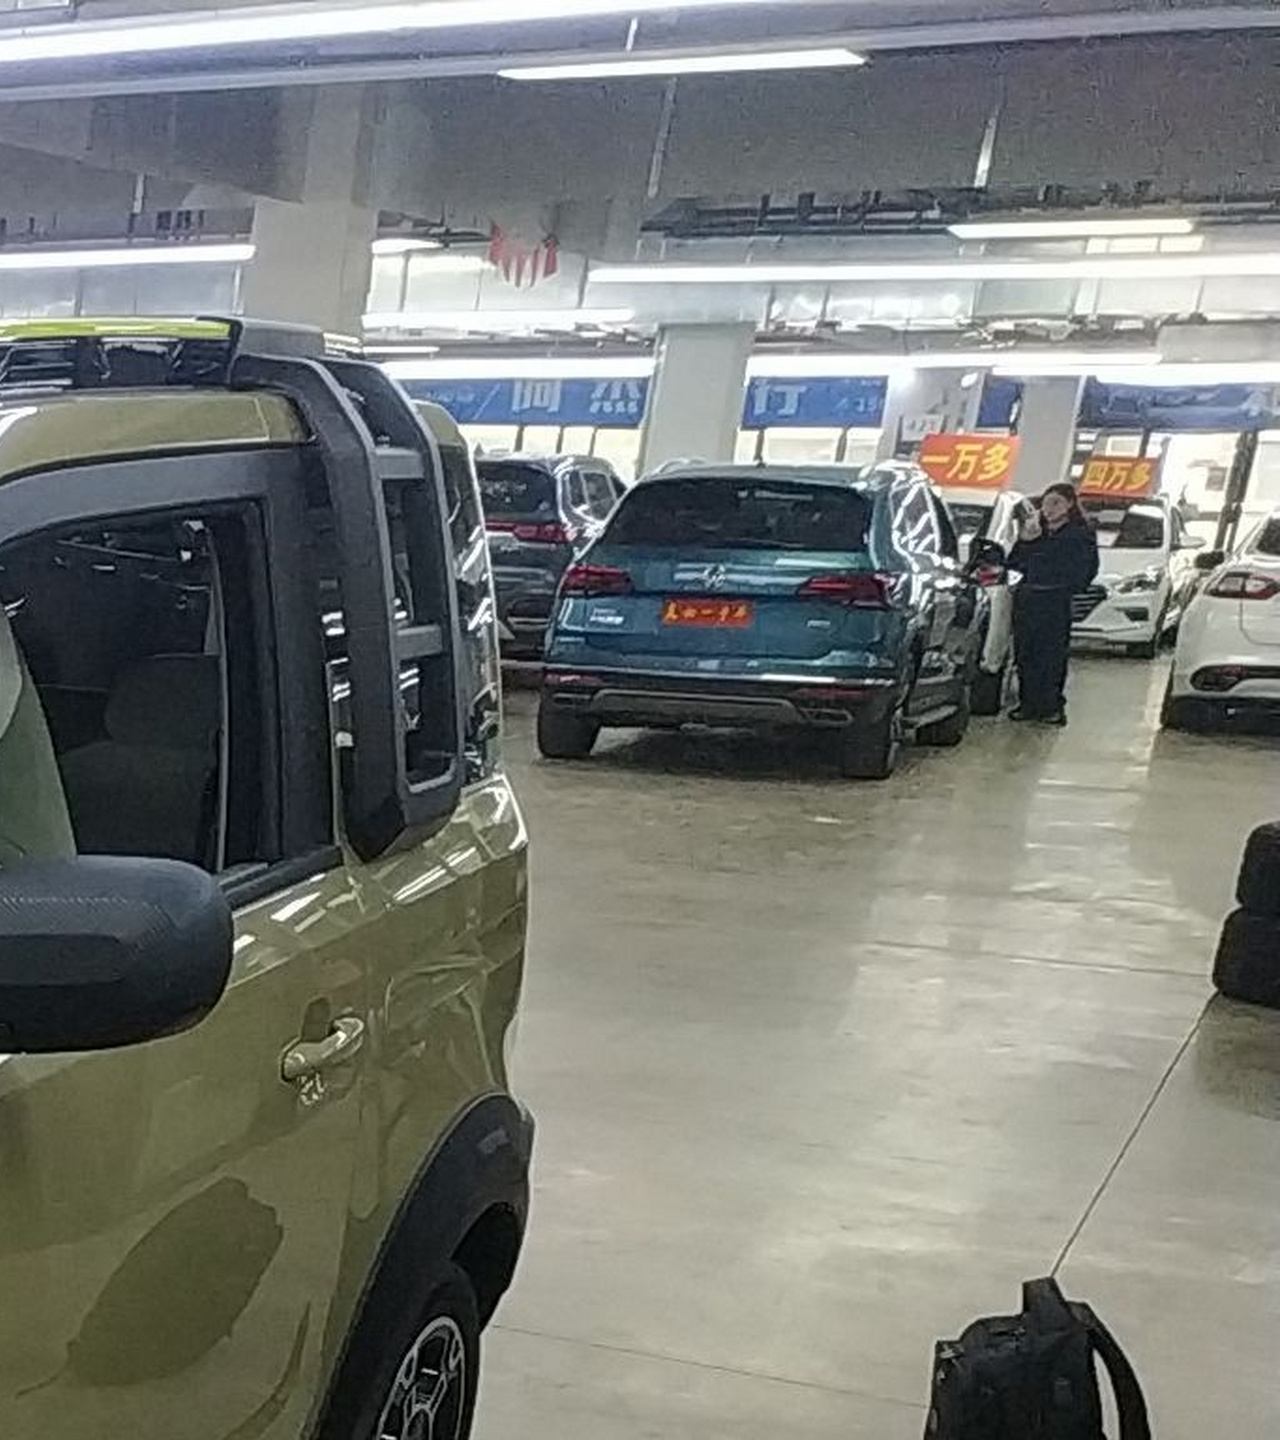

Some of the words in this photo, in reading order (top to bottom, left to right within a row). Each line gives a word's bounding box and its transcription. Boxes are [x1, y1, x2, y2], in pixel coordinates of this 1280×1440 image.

[922, 443, 1011, 481] 一万多
[1083, 460, 1151, 488] 四万多
